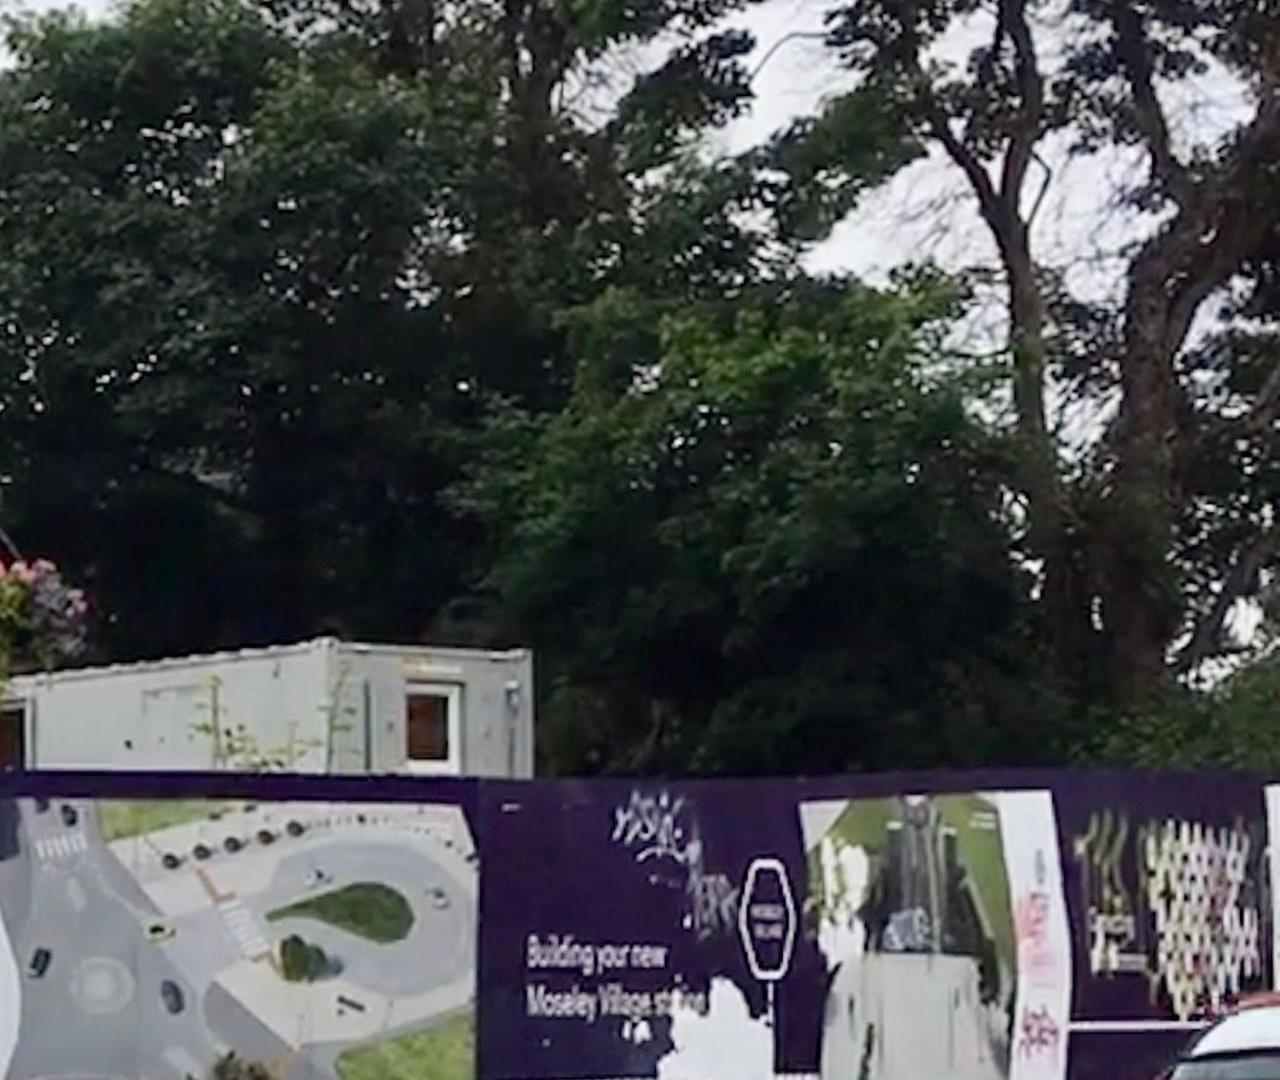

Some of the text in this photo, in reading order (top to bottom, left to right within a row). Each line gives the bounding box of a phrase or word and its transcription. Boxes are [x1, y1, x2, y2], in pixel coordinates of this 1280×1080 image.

[527, 934, 667, 975] Building your new
[527, 983, 597, 1024] Moseley
[598, 983, 651, 1023] Village
